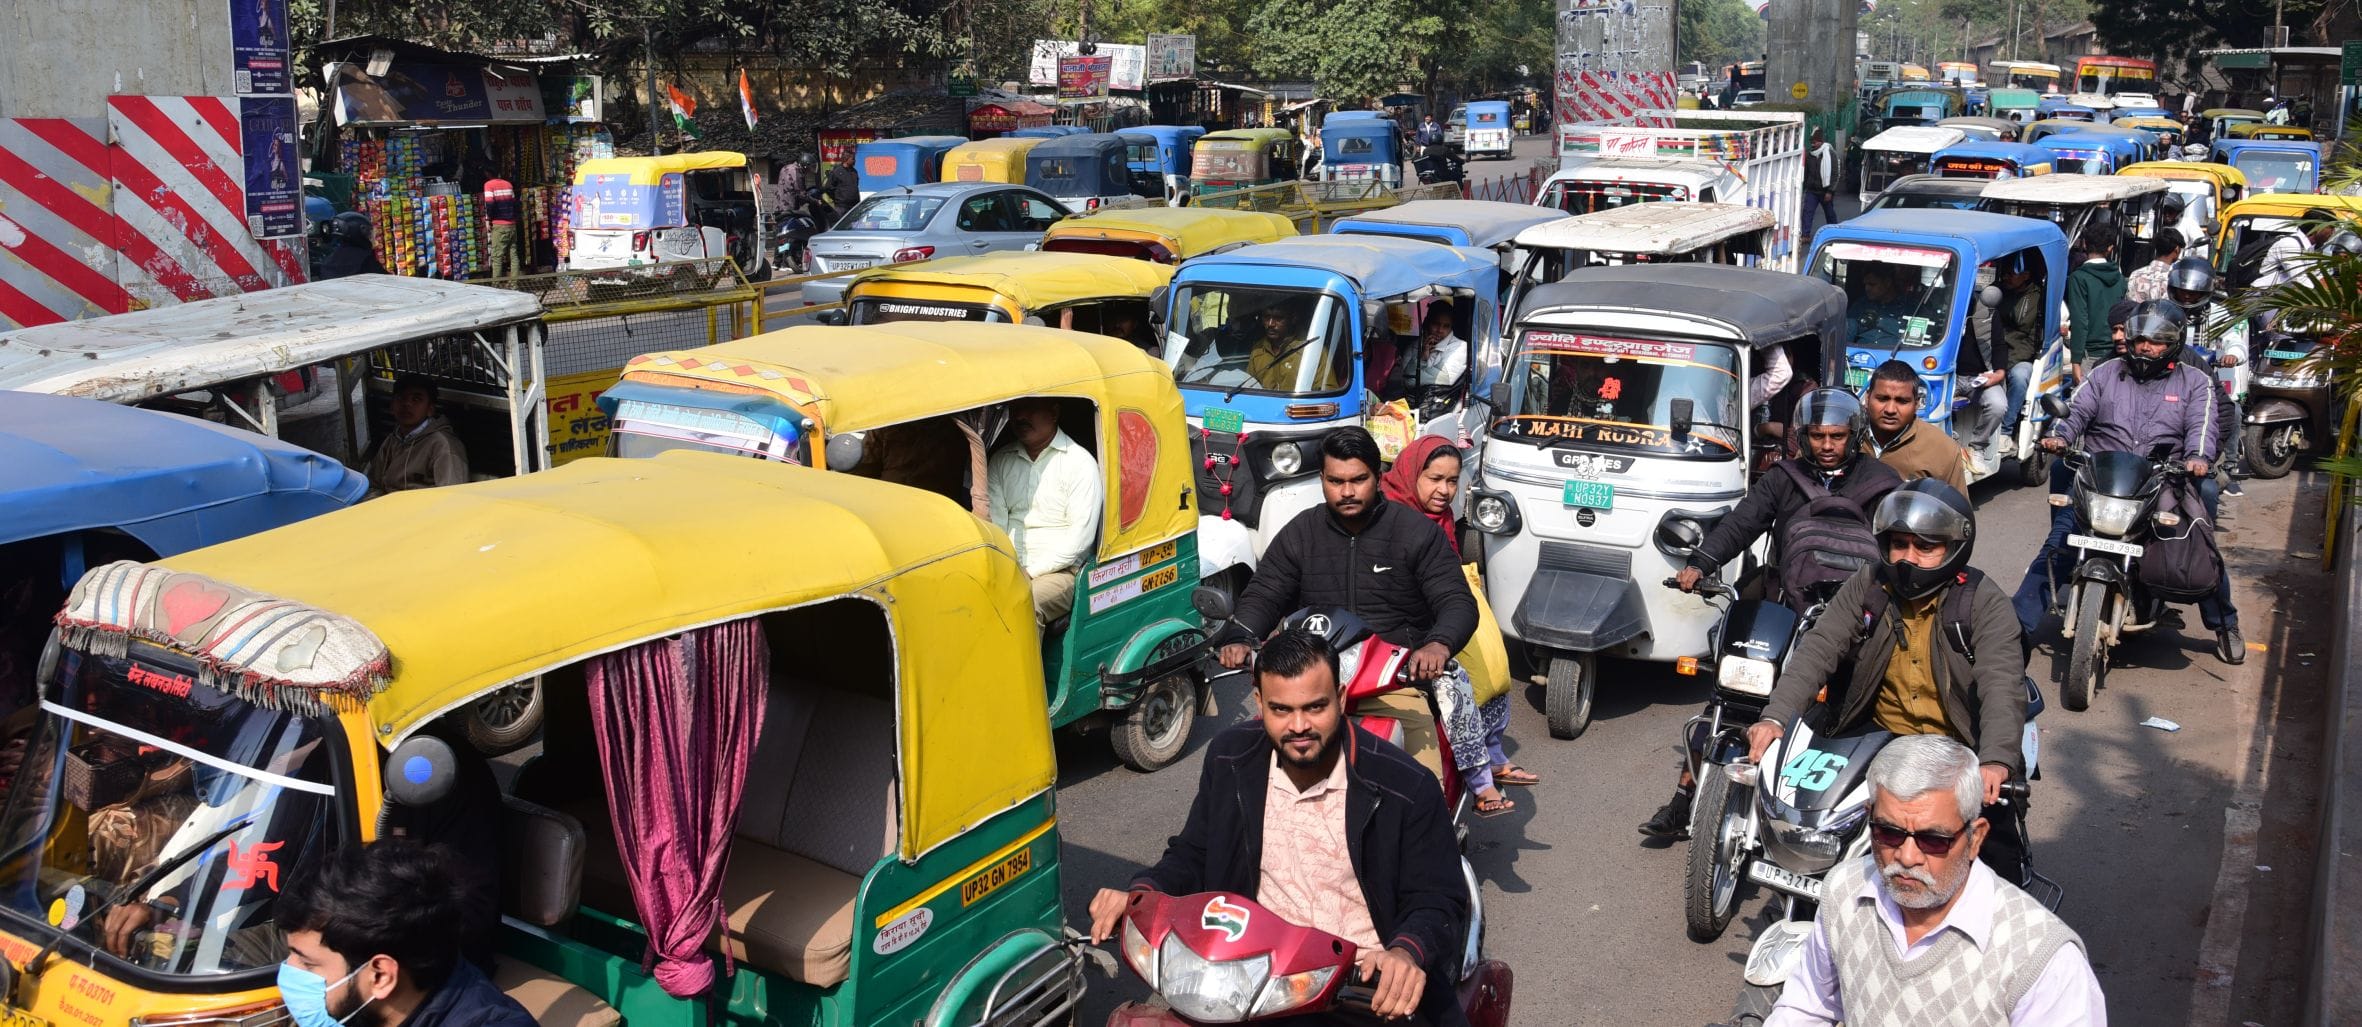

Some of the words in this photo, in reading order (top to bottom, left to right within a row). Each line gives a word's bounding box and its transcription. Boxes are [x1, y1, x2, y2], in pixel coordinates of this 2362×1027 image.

[446, 99, 482, 113] Thunder
[496, 99, 513, 112] पान
[889, 304, 920, 315] BRIGHT
[920, 305, 967, 318] INDUSTRIES
[1528, 421, 1584, 439] MAHI
[1596, 428, 1673, 448] RUDRA
[1562, 454, 1622, 470] GRES
[1575, 482, 1609, 495] UP32Y
[1574, 493, 1608, 506] N0937
[964, 879, 989, 901] UP32
[991, 869, 1005, 887] GN
[1007, 854, 1028, 877] 7954
[881, 920, 907, 940] किराया
[909, 909, 926, 926] सूची
